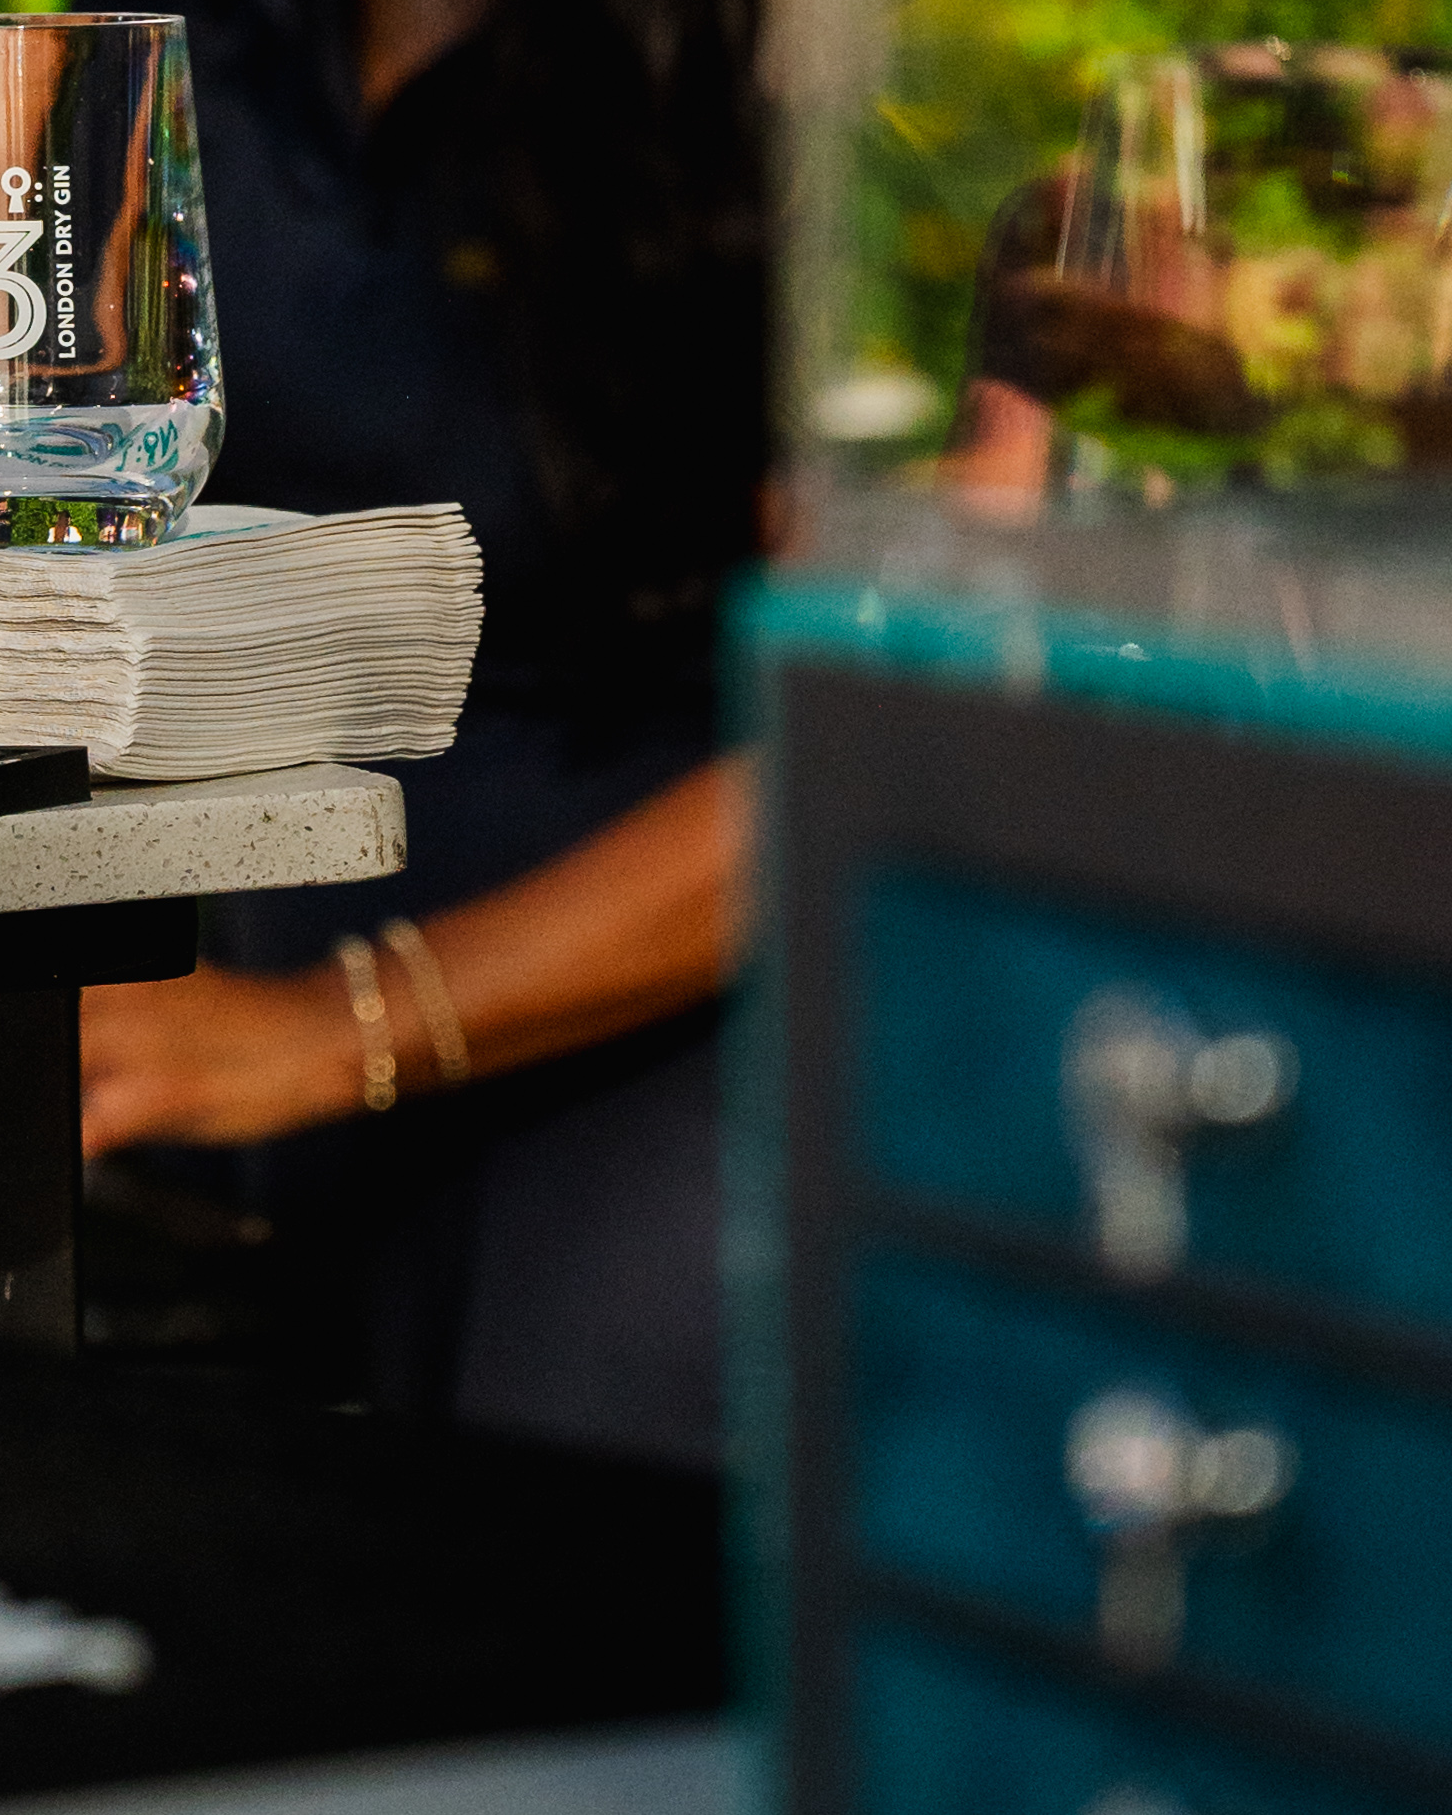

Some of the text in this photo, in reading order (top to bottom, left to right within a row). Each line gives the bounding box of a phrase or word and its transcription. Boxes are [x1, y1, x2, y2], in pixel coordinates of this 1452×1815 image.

[53, 165, 76, 359] LONDON DRY GIN
